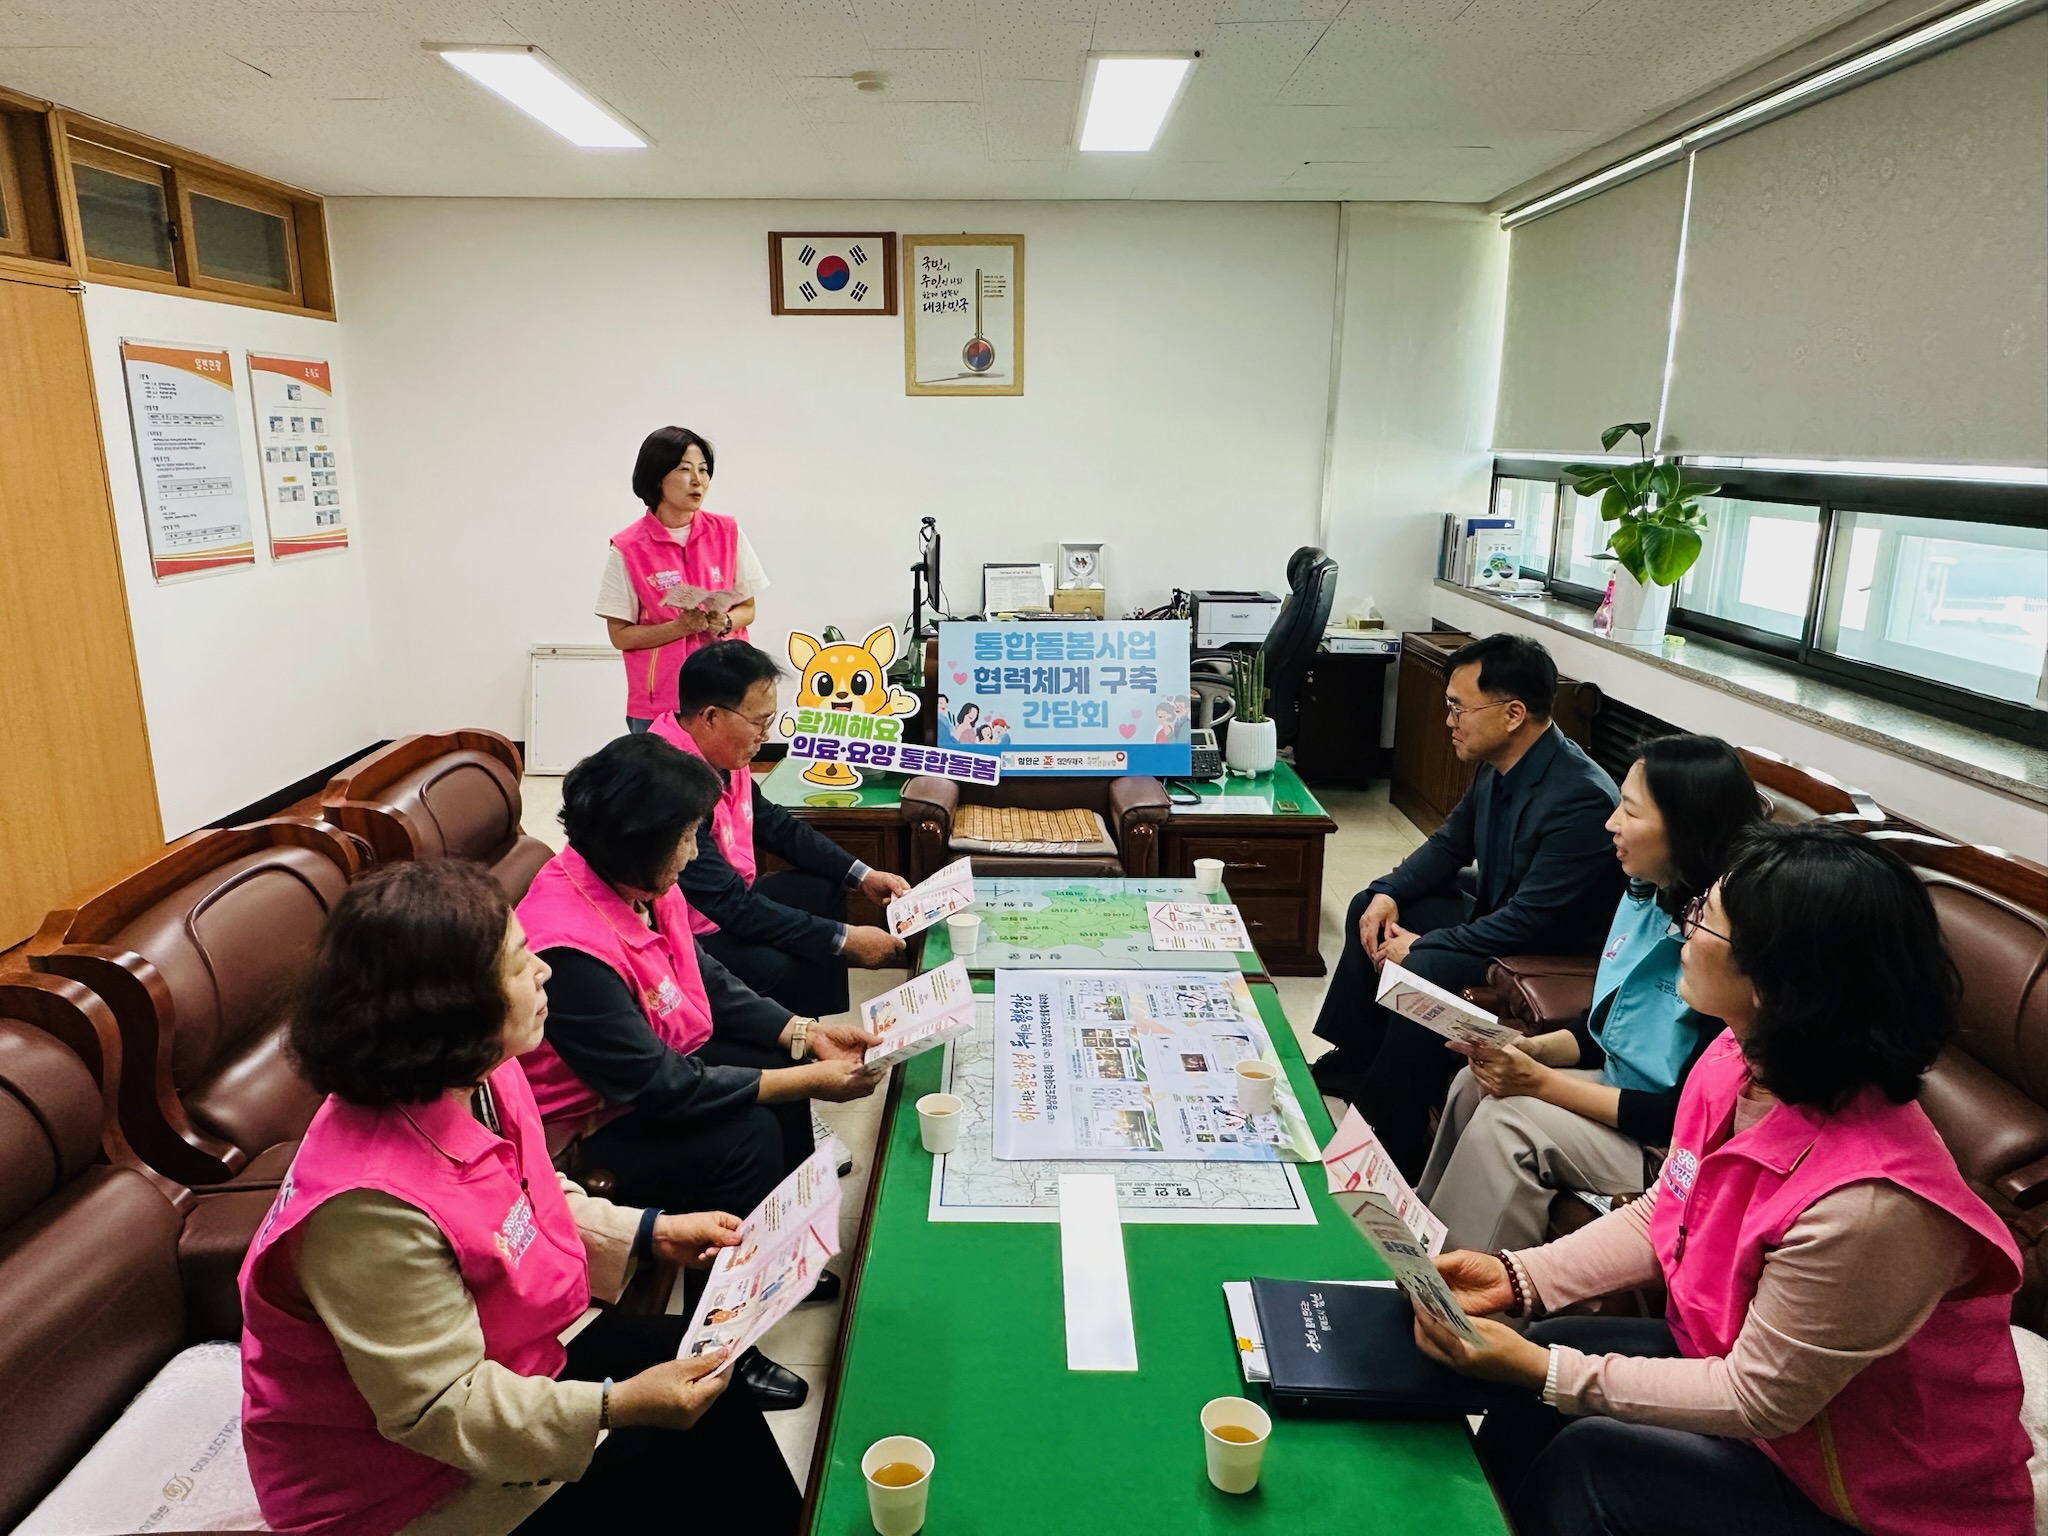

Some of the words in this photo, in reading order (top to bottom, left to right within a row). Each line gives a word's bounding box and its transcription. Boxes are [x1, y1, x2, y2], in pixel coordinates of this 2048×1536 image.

[922, 256, 950, 272] 국민이
[921, 274, 949, 289] 주인인
[923, 298, 969, 314] 대한민국
[974, 631, 1156, 661] 통합돌봄사업
[973, 666, 1090, 695] 협력체계
[1099, 665, 1158, 694] 구축
[797, 710, 900, 743] 함께해요
[1022, 700, 1109, 728] 간담회
[791, 736, 897, 767] 의료·요양
[898, 747, 997, 782] 통합돌봄
[1017, 757, 1040, 766] 함안군
